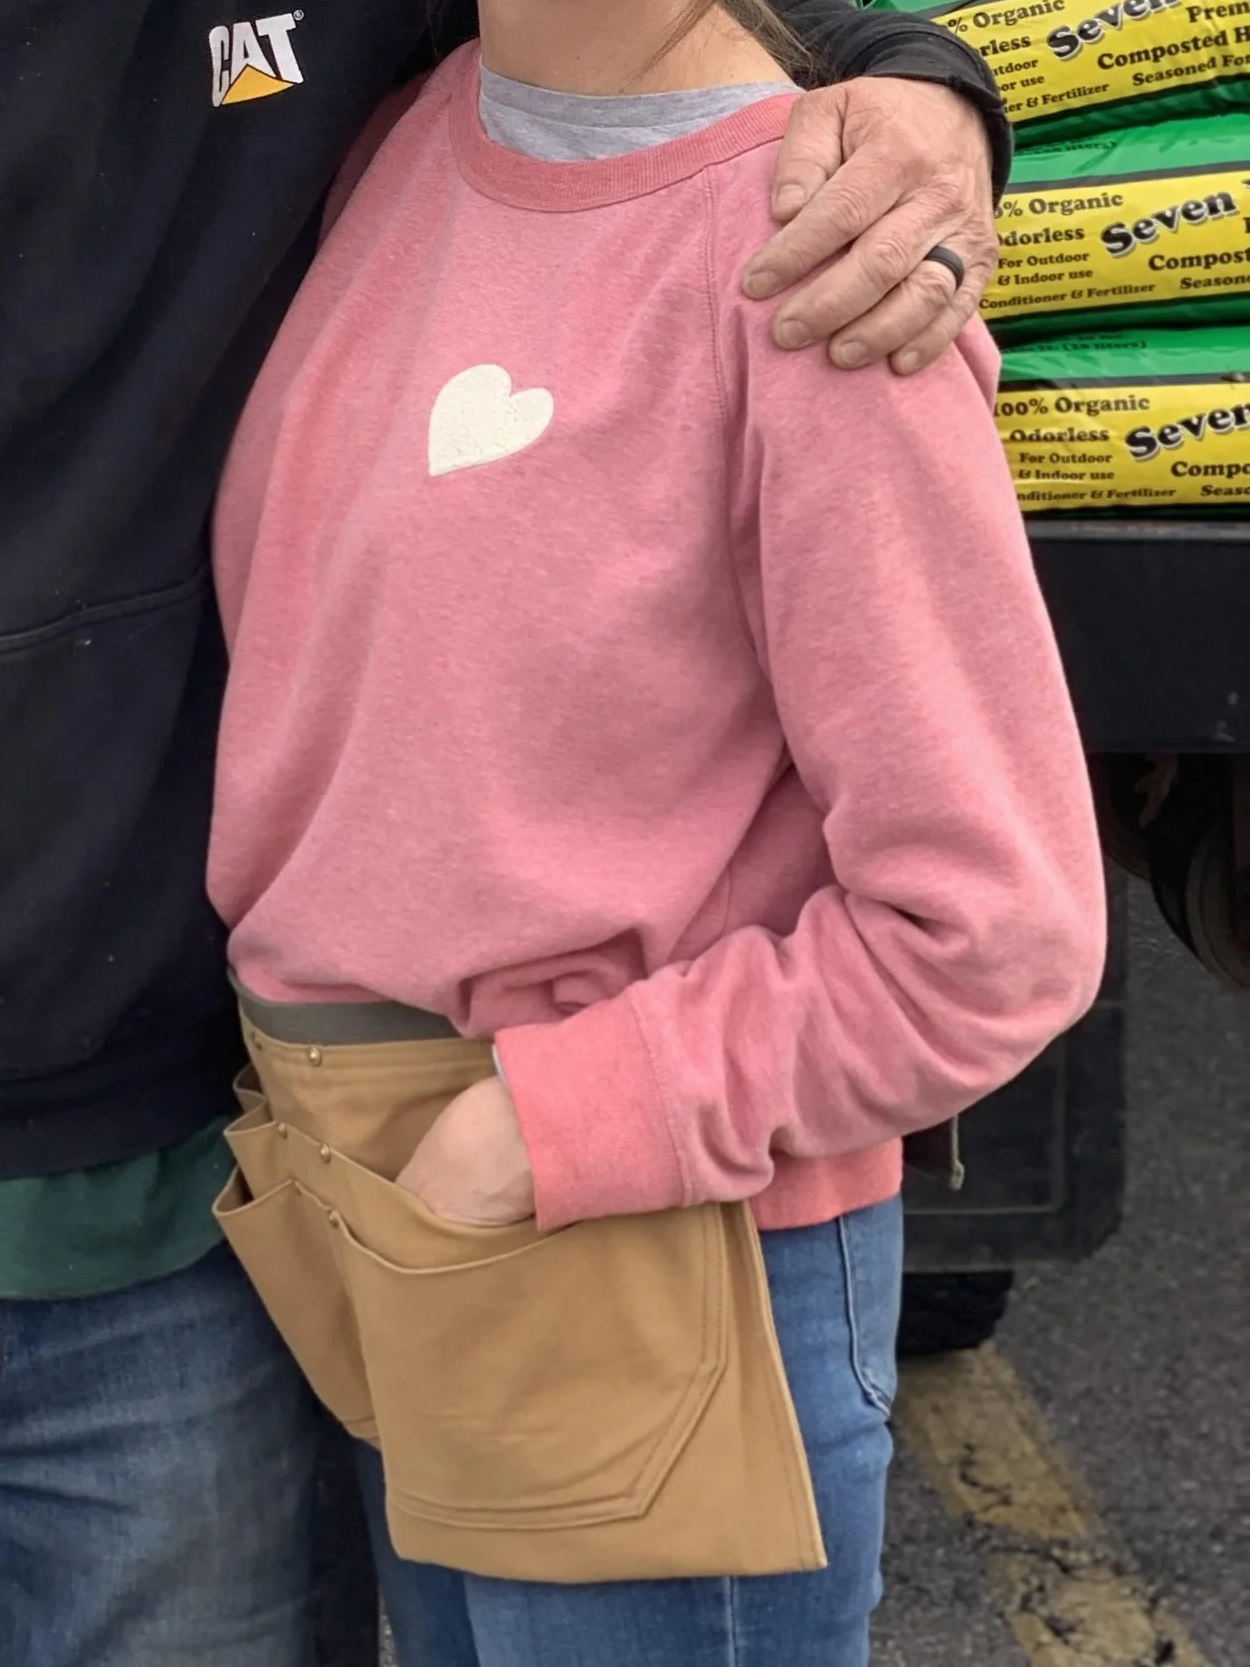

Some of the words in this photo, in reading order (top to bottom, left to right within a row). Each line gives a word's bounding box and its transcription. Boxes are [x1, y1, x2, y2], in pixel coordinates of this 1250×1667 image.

[209, 13, 304, 107] CAT
[1097, 34, 1228, 71] Composted
[1132, 58, 1217, 86] Seasoned
[1042, 83, 1110, 105] Fertilizer
[1029, 193, 1123, 215] Organic
[1100, 190, 1239, 257] Seven
[1027, 252, 1089, 266] Outdoor
[1014, 272, 1065, 285] Indoor
[1069, 269, 1093, 280] use
[979, 292, 1066, 309] Conditioner
[1087, 284, 1156, 298] Fertilizer
[995, 398, 1049, 416] 100%
[1055, 395, 1150, 416] Organic
[1010, 428, 1110, 443] Odorless
[1019, 453, 1045, 463] For
[1049, 453, 1113, 464] Outdoor
[1035, 470, 1084, 480] Indoor
[1107, 488, 1177, 499] Fertilizer
